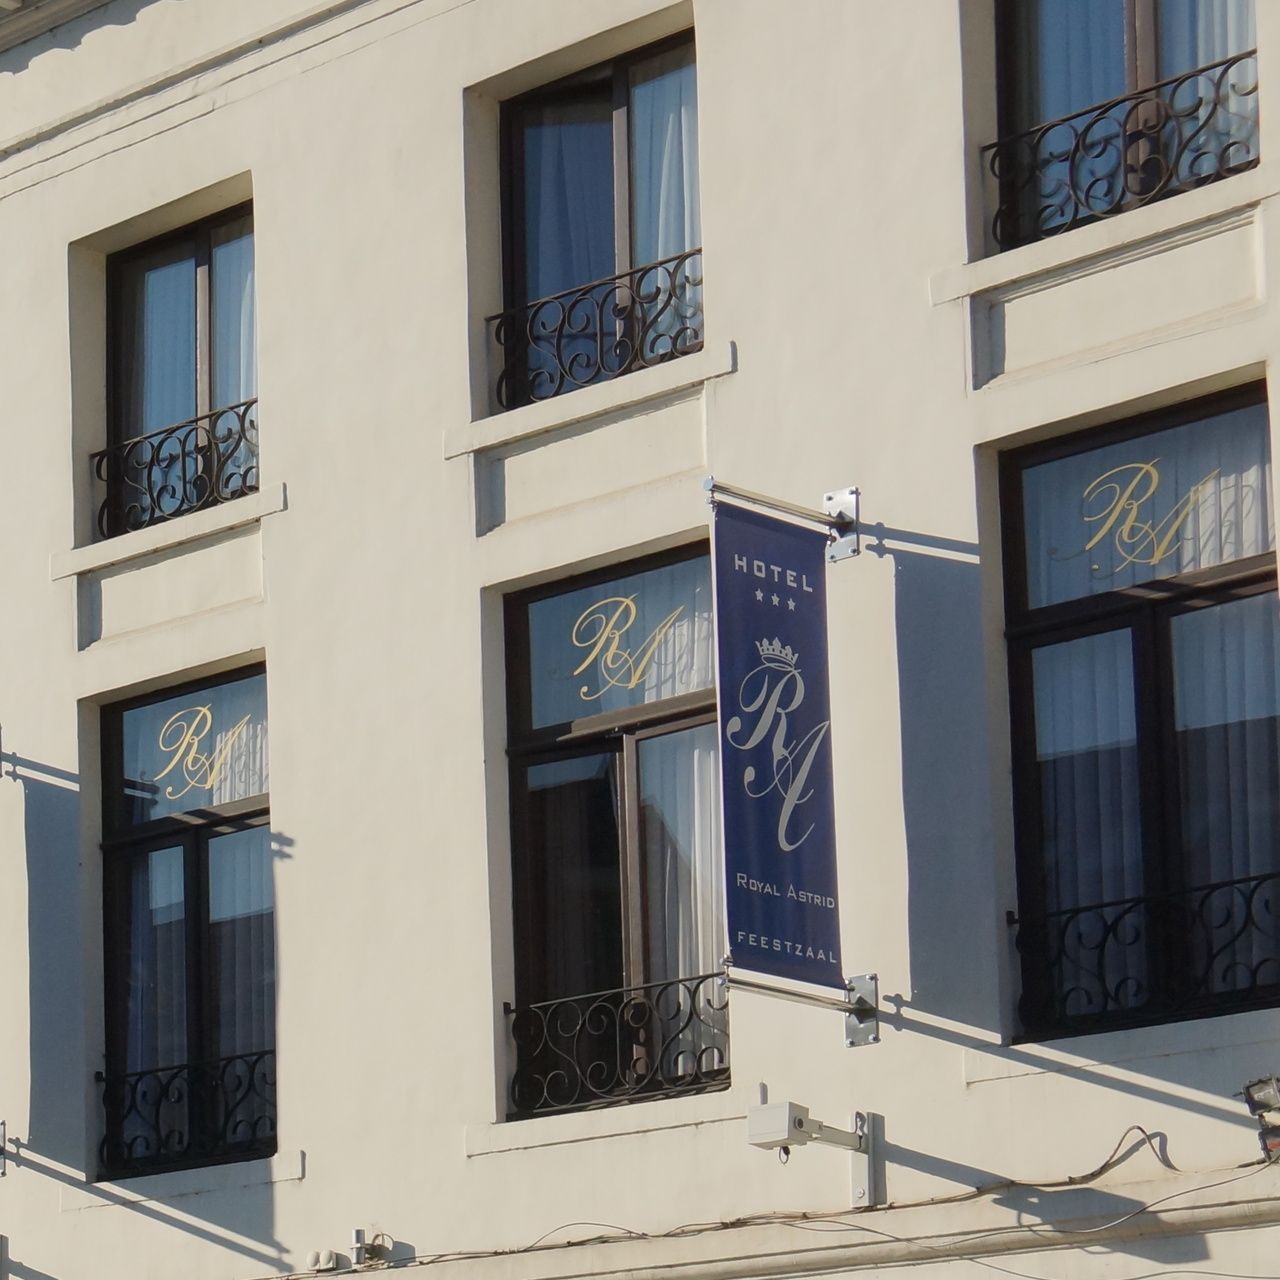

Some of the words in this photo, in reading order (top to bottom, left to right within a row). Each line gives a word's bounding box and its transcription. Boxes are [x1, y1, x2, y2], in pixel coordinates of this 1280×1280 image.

[734, 554, 813, 592] HOTEL
[737, 873, 781, 897] ROYAL
[787, 884, 835, 908] ASTRID
[738, 931, 837, 963] FEESTZAAL
